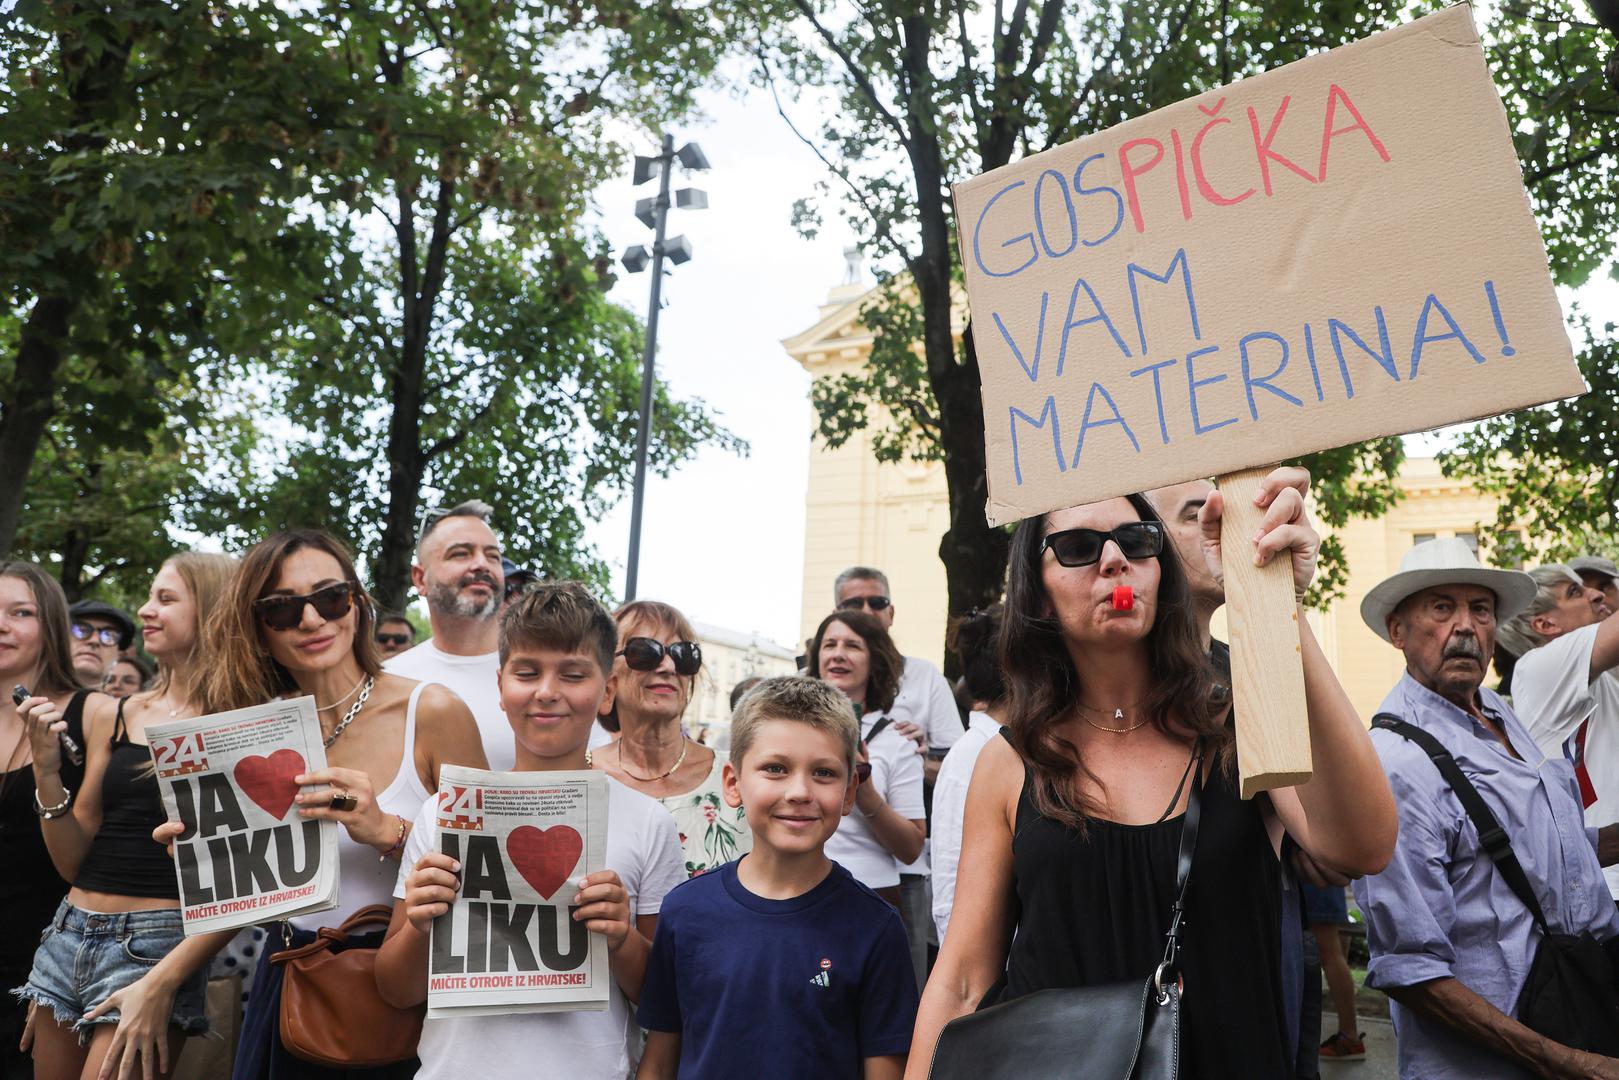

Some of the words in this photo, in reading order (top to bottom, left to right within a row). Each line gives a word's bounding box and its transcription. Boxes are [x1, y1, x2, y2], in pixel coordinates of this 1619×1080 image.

[973, 83, 1391, 277] GOSPIČKA
[992, 248, 1200, 381] VAM
[1009, 280, 1516, 486] MATERINA!
[1115, 708, 1124, 718] A
[152, 733, 207, 769] 24
[160, 765, 209, 778] SATA
[171, 772, 249, 842] JA
[439, 784, 483, 822] 24
[177, 820, 321, 908] LIKU
[185, 902, 219, 921] MIČITE
[220, 897, 257, 914] OTROVE
[259, 896, 268, 907] IZ
[269, 885, 316, 905] HRVATSKE!
[432, 901, 589, 975] LIKU
[431, 976, 467, 991] MIČITE
[470, 975, 513, 988] OTROVE
[516, 975, 525, 987] IZ
[528, 973, 586, 987] HRVATSKE!
